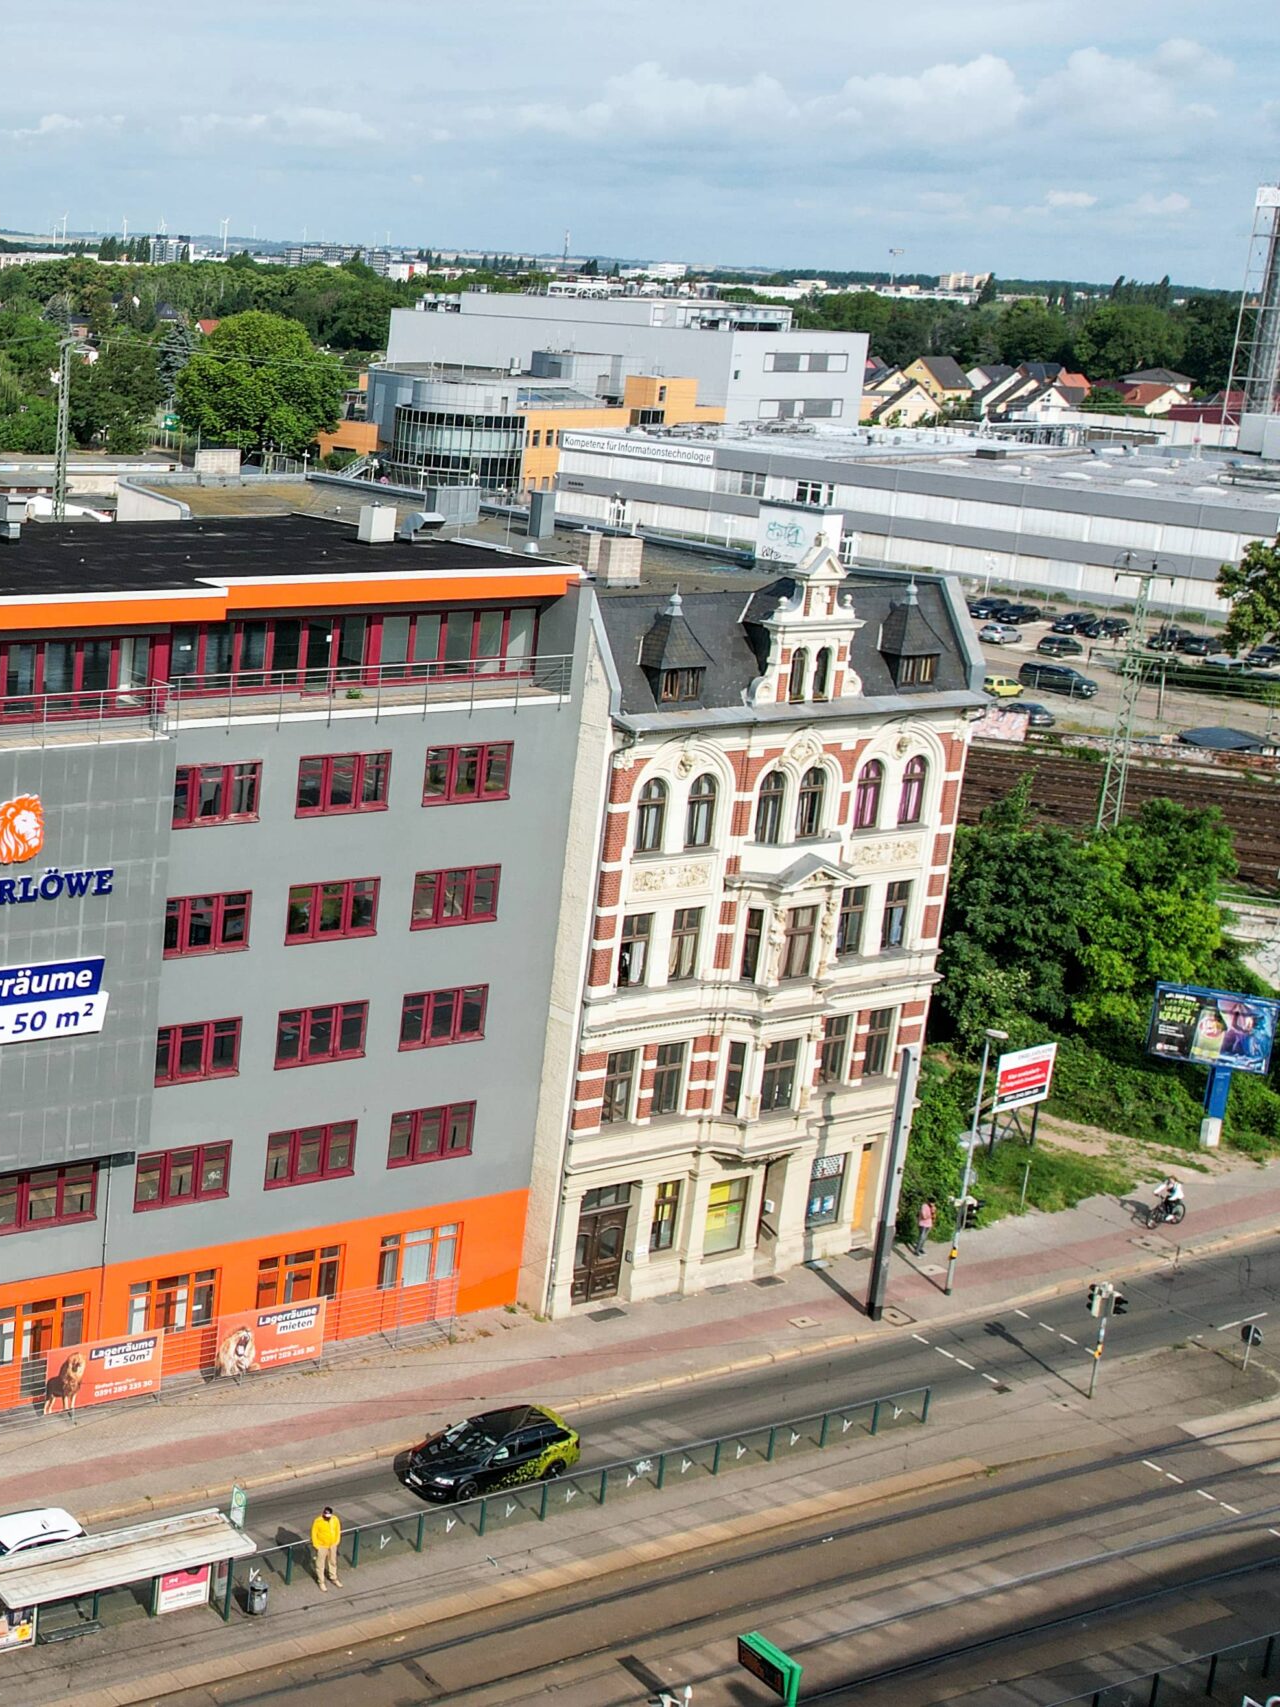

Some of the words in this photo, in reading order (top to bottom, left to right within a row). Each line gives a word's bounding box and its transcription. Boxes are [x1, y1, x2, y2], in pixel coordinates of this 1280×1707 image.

[565, 435, 605, 449] Kompetenz
[606, 440, 618, 450] für
[618, 442, 711, 463] Informationstechnologie
[11, 1010, 47, 1034] 50
[55, 1002, 94, 1028] m²
[258, 1307, 317, 1326] Lagerräume
[279, 1318, 313, 1332] mieten
[91, 1339, 155, 1359] Lagerräume
[107, 1359, 113, 1367] 1
